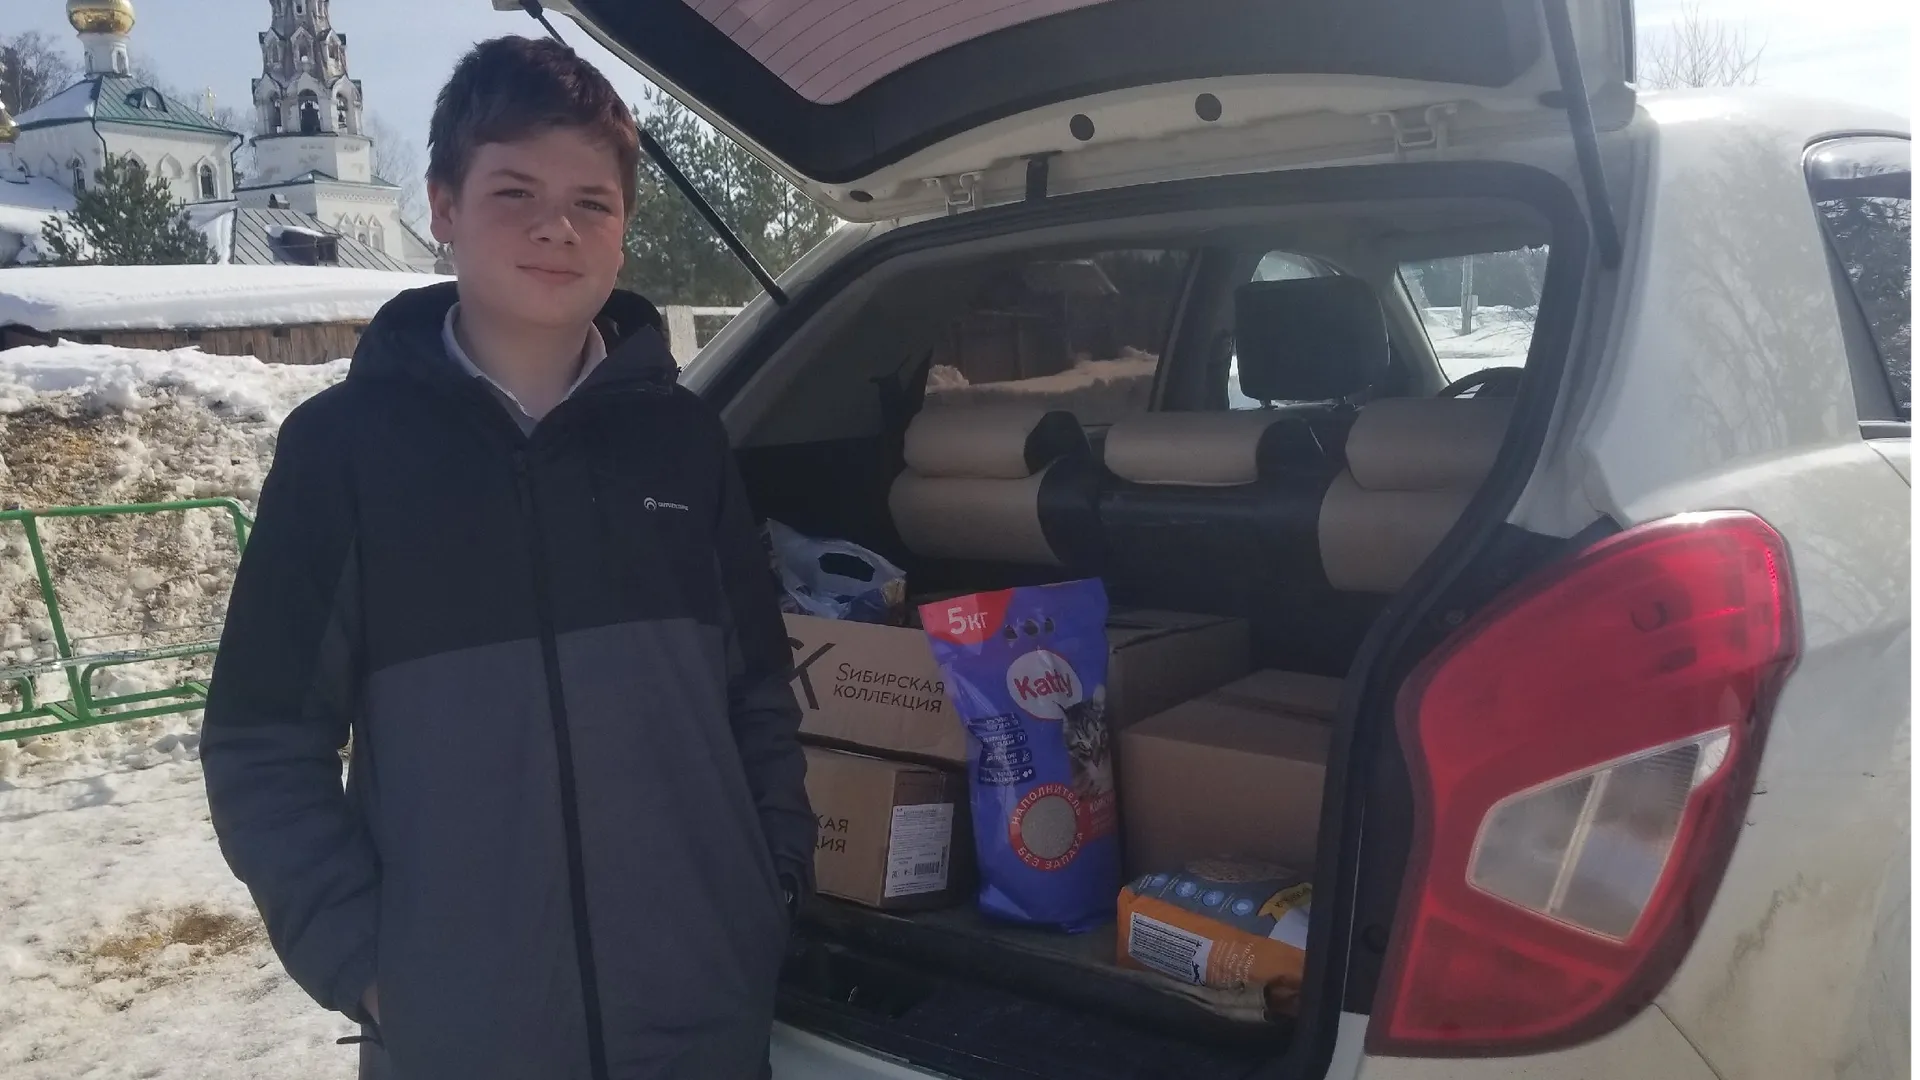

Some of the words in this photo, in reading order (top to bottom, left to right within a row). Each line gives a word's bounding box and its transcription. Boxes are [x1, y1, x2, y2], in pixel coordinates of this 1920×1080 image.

[833, 684, 942, 713] КОЛЛЕКЦИЯ
[1013, 669, 1074, 700] Katty
[1012, 784, 1081, 825] НАПОЛНИТЕЛЬ
[1018, 845, 1040, 867] БЕЗ
[1045, 832, 1083, 869] ЗАПАХА
